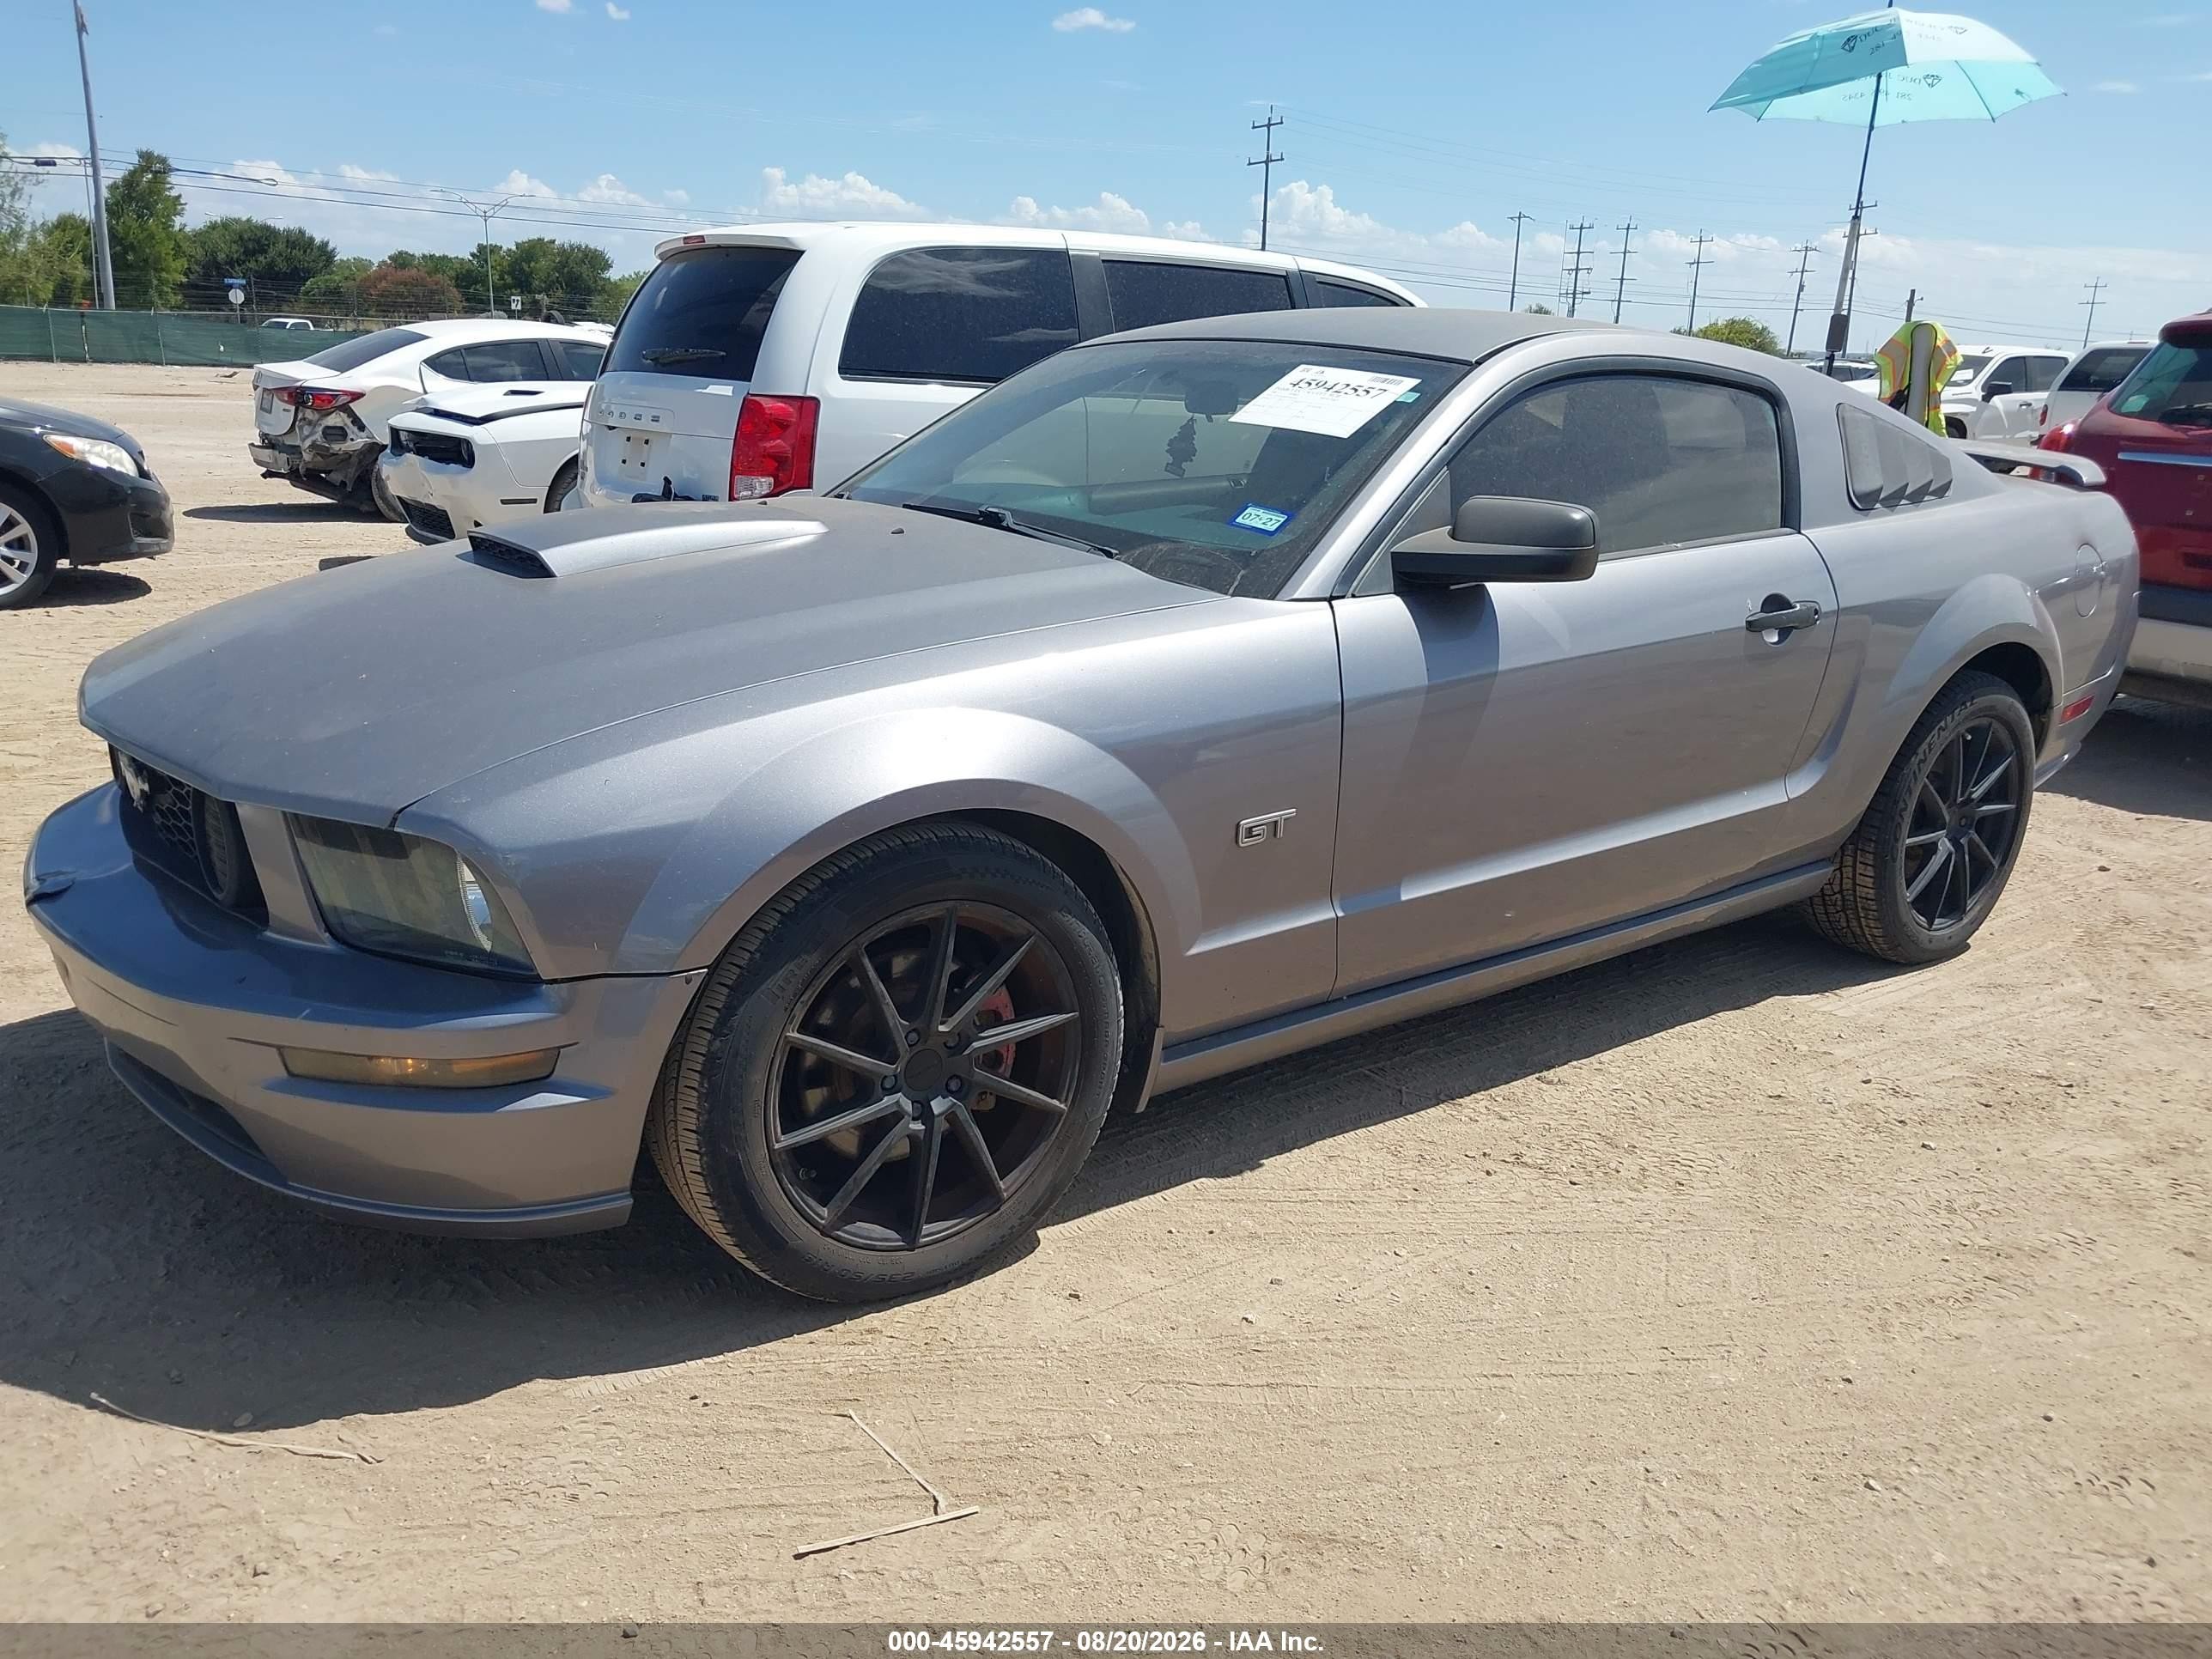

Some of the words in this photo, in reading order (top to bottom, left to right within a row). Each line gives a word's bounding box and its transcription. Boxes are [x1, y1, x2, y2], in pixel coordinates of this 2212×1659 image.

[1290, 378, 1388, 398] 45942557
[1242, 512, 1260, 522] 07
[1261, 517, 1281, 527] 27
[1237, 808, 1297, 847] GT
